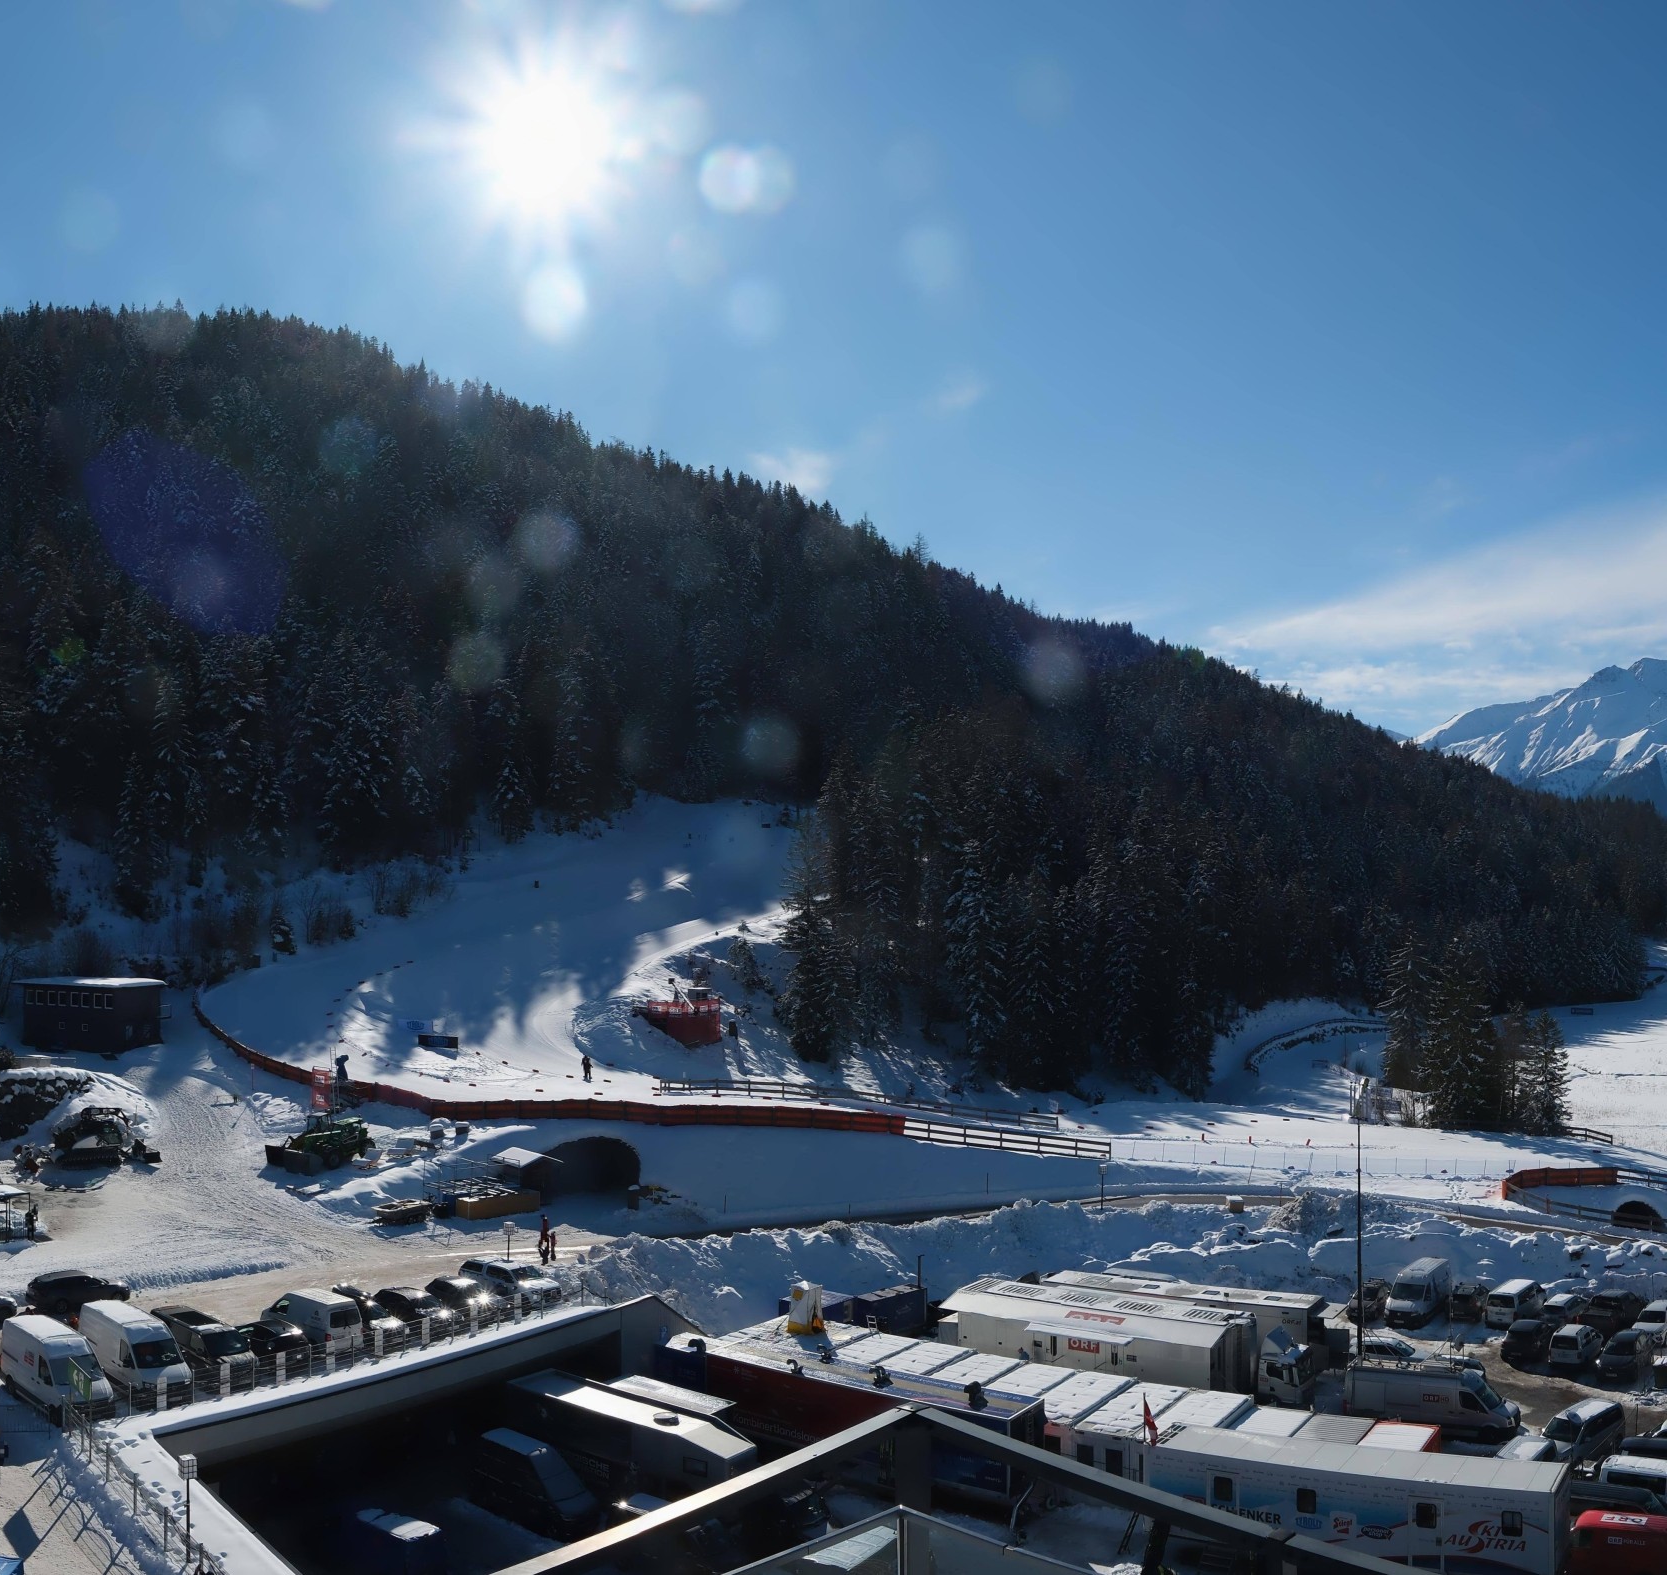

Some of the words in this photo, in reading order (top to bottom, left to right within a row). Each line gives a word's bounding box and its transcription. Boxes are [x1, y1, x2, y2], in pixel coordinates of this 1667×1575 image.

[1070, 1338, 1097, 1351] ORF
[1296, 1516, 1322, 1529] TYROLIT
[1333, 1517, 1353, 1530] Stiegl
[1605, 1514, 1643, 1526] ORF
[1364, 1526, 1389, 1534] personal
[1445, 1534, 1526, 1553] AUSTRIA
